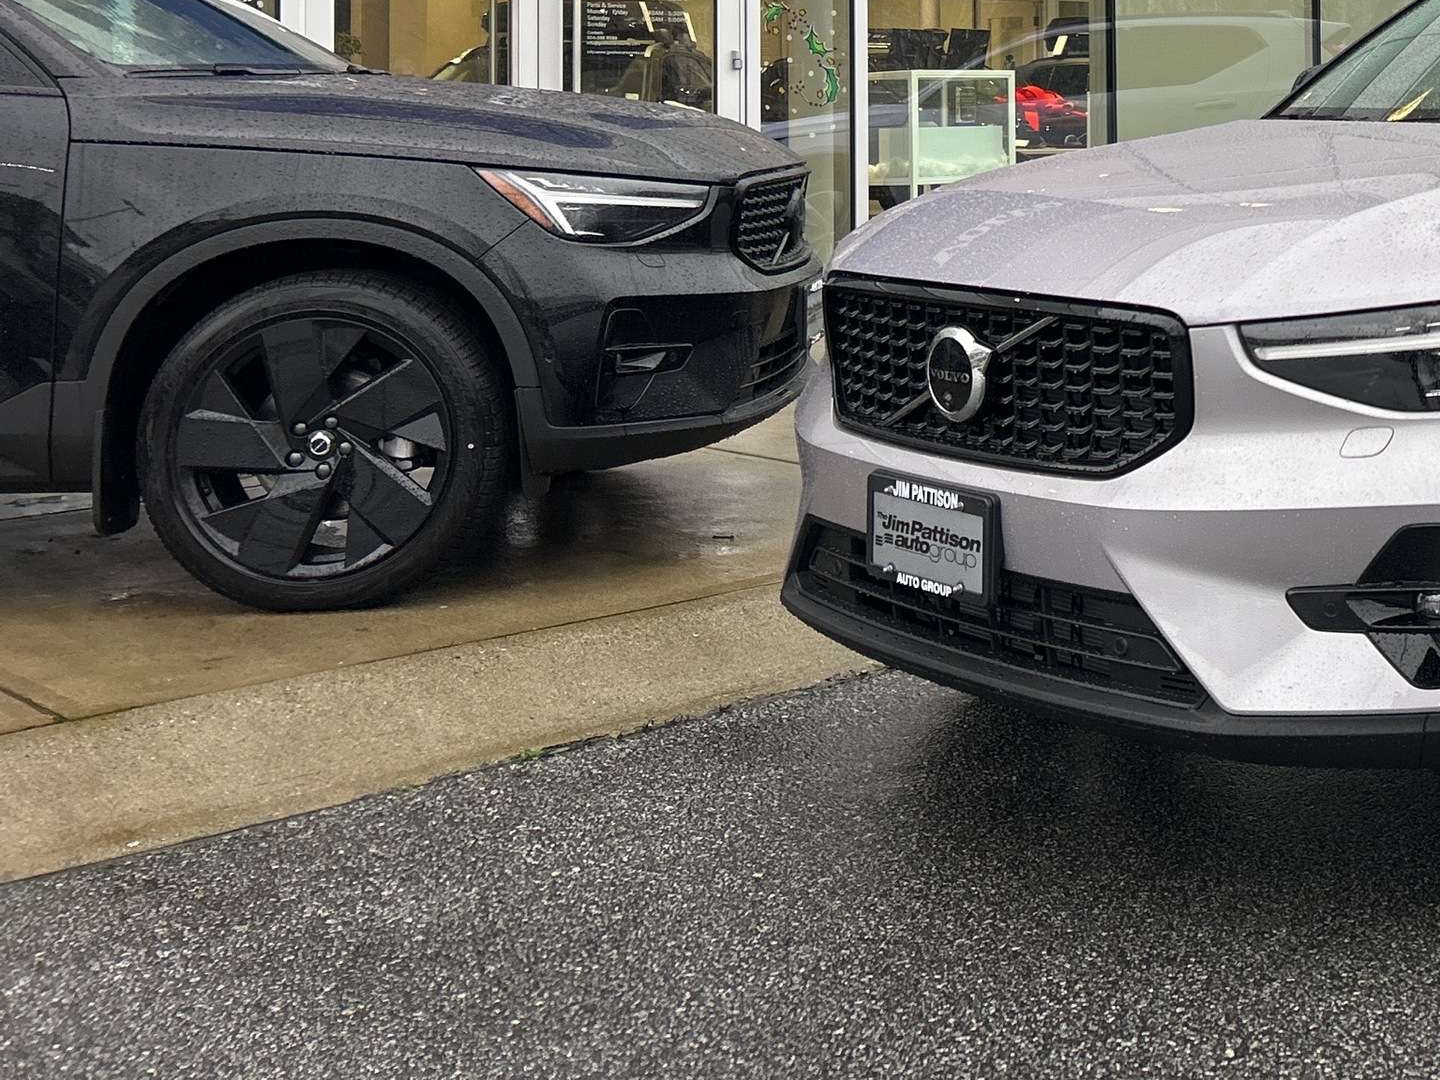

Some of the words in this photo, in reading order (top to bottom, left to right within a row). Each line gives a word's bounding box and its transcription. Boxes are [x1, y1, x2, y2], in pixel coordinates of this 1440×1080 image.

[931, 368, 970, 384] VOLVO
[892, 479, 910, 499] JIM
[911, 483, 959, 510] PATTISON
[896, 572, 919, 589] AUTO
[920, 579, 952, 598] GROUP
